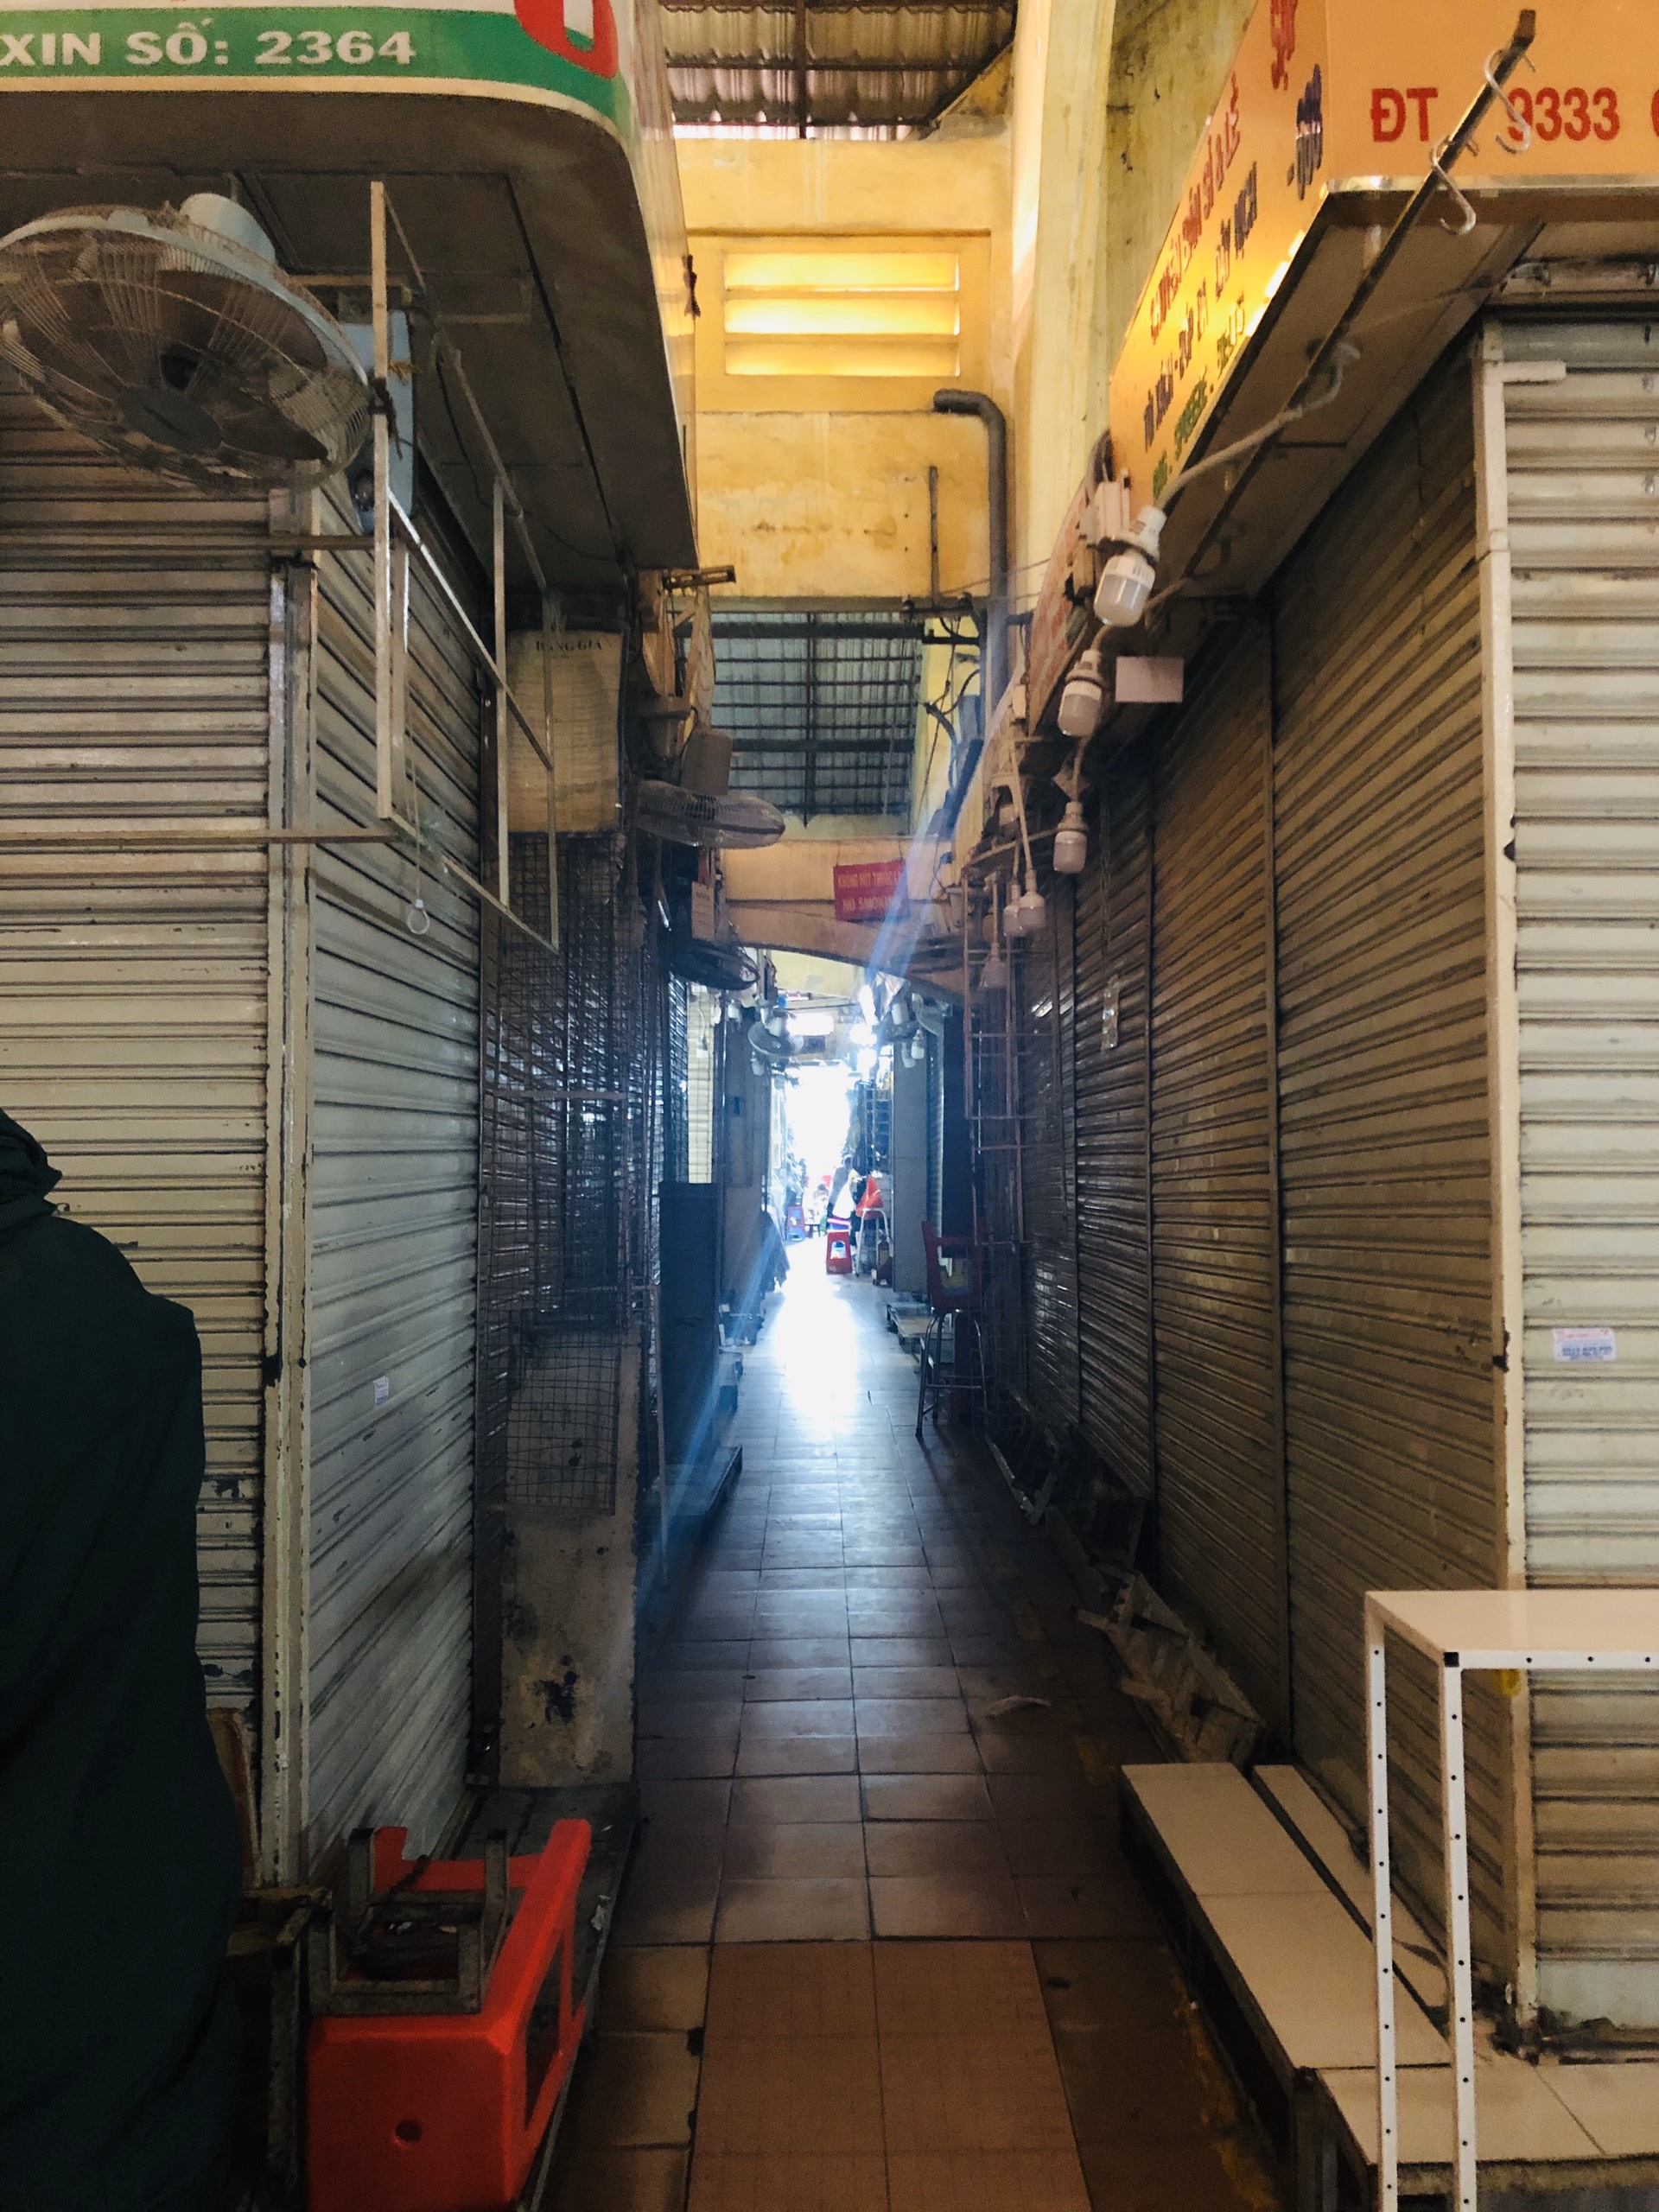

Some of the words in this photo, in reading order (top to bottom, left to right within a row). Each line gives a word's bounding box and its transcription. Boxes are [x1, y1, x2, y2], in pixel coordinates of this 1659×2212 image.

[0, 33, 101, 66] XIN
[126, 17, 229, 66] SỐ:
[256, 31, 417, 66] 2364
[1370, 86, 1439, 143] ĐT
[1506, 86, 1621, 142] 9333
